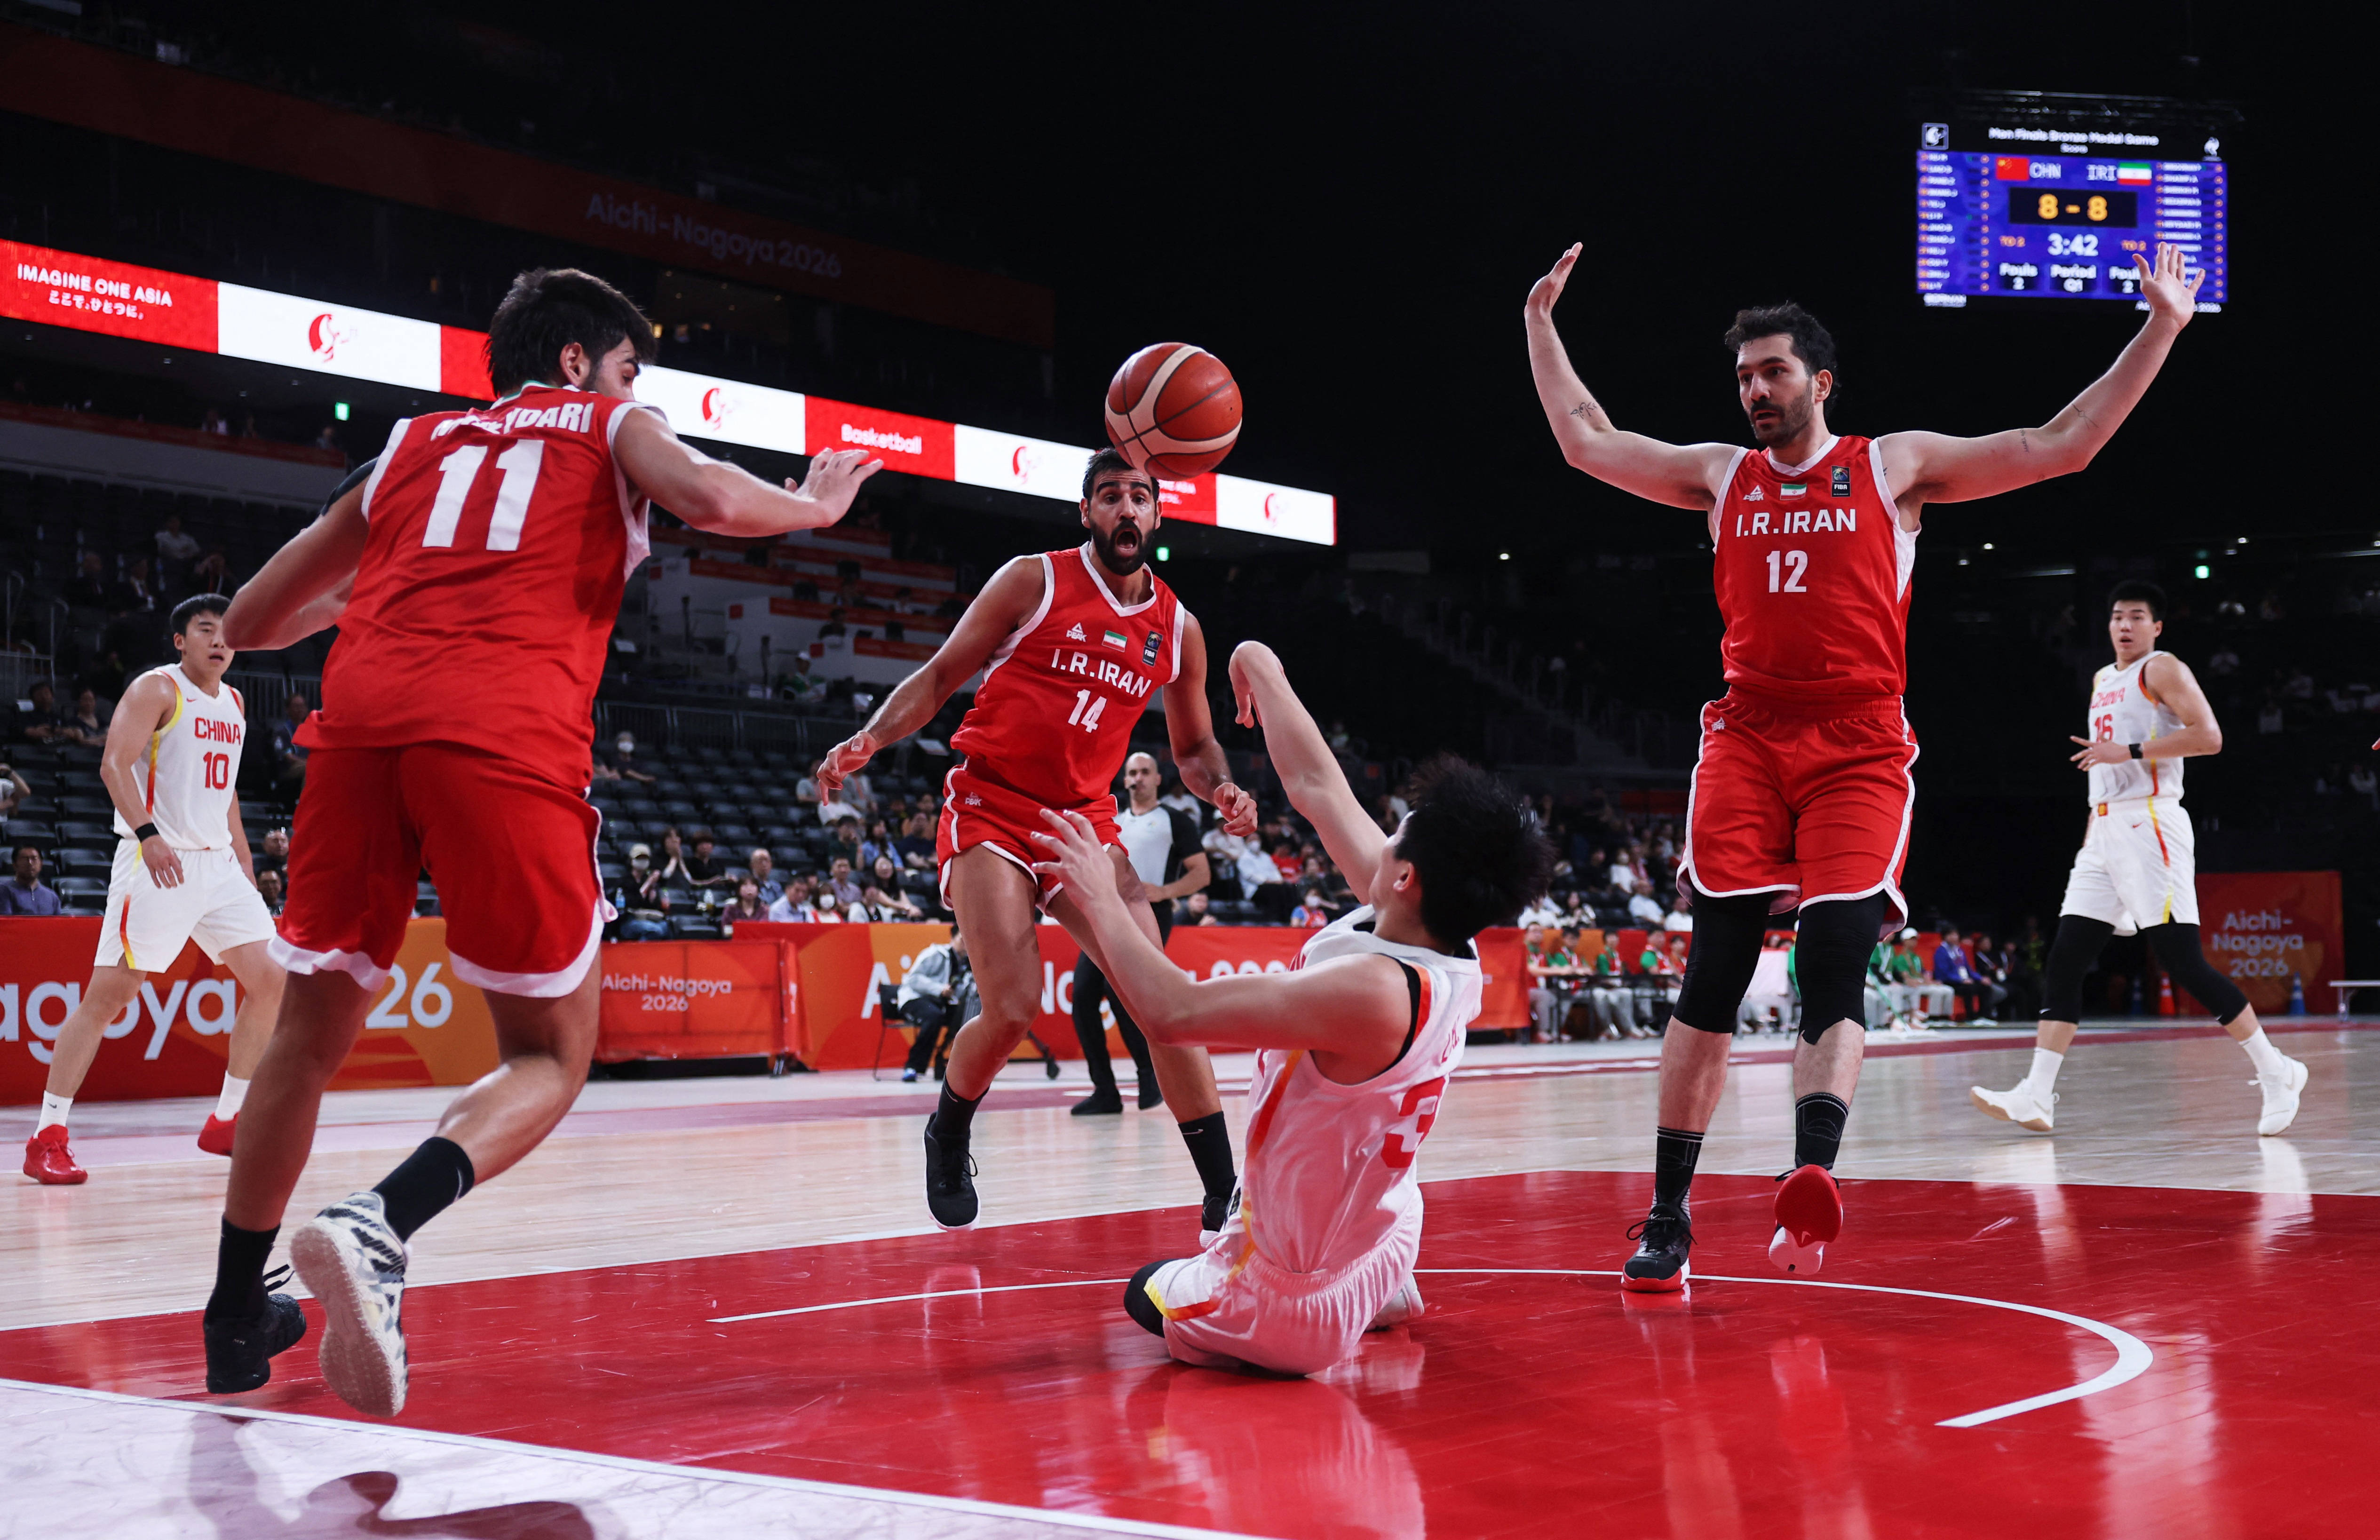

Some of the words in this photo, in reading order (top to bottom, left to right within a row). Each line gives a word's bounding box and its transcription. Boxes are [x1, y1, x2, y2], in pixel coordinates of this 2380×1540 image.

[2124, 133, 2159, 146] Game
[2029, 162, 2061, 179] CHN
[2086, 165, 2117, 181] IRI
[2038, 193, 2059, 220] 8
[2087, 196, 2108, 222] 8
[586, 192, 774, 266] Aichi-Nagoya
[777, 239, 843, 278] 2026
[2047, 233, 2098, 256] 3:42
[1999, 262, 2038, 277] Fouls
[2050, 263, 2096, 279] Period
[2109, 266, 2141, 280] Foul
[17, 263, 92, 292] IMAGINE
[95, 278, 130, 299] ONE
[134, 286, 173, 307] ASIA
[2013, 277, 2024, 290] 2
[2122, 280, 2134, 294] 2
[841, 423, 922, 455] Basketball
[422, 439, 545, 551] 11
[1736, 508, 1856, 537] I.R.IRAN
[1766, 550, 1808, 594] 12
[1066, 629, 1087, 642] PEAK
[1144, 649, 1155, 658] FIBA
[1051, 648, 1151, 698] I.R.IRAN
[1068, 689, 1107, 733] 14
[195, 717, 241, 746] CHINA
[2094, 714, 2113, 742] 16
[203, 752, 229, 790] 10
[965, 797, 982, 806] PEAK
[2222, 909, 2293, 930] Aichi-
[2212, 933, 2304, 956] Nagoya
[2229, 958, 2289, 977] 2026
[602, 973, 732, 998] Aichi-Nagoya
[642, 995, 689, 1012] 2026
